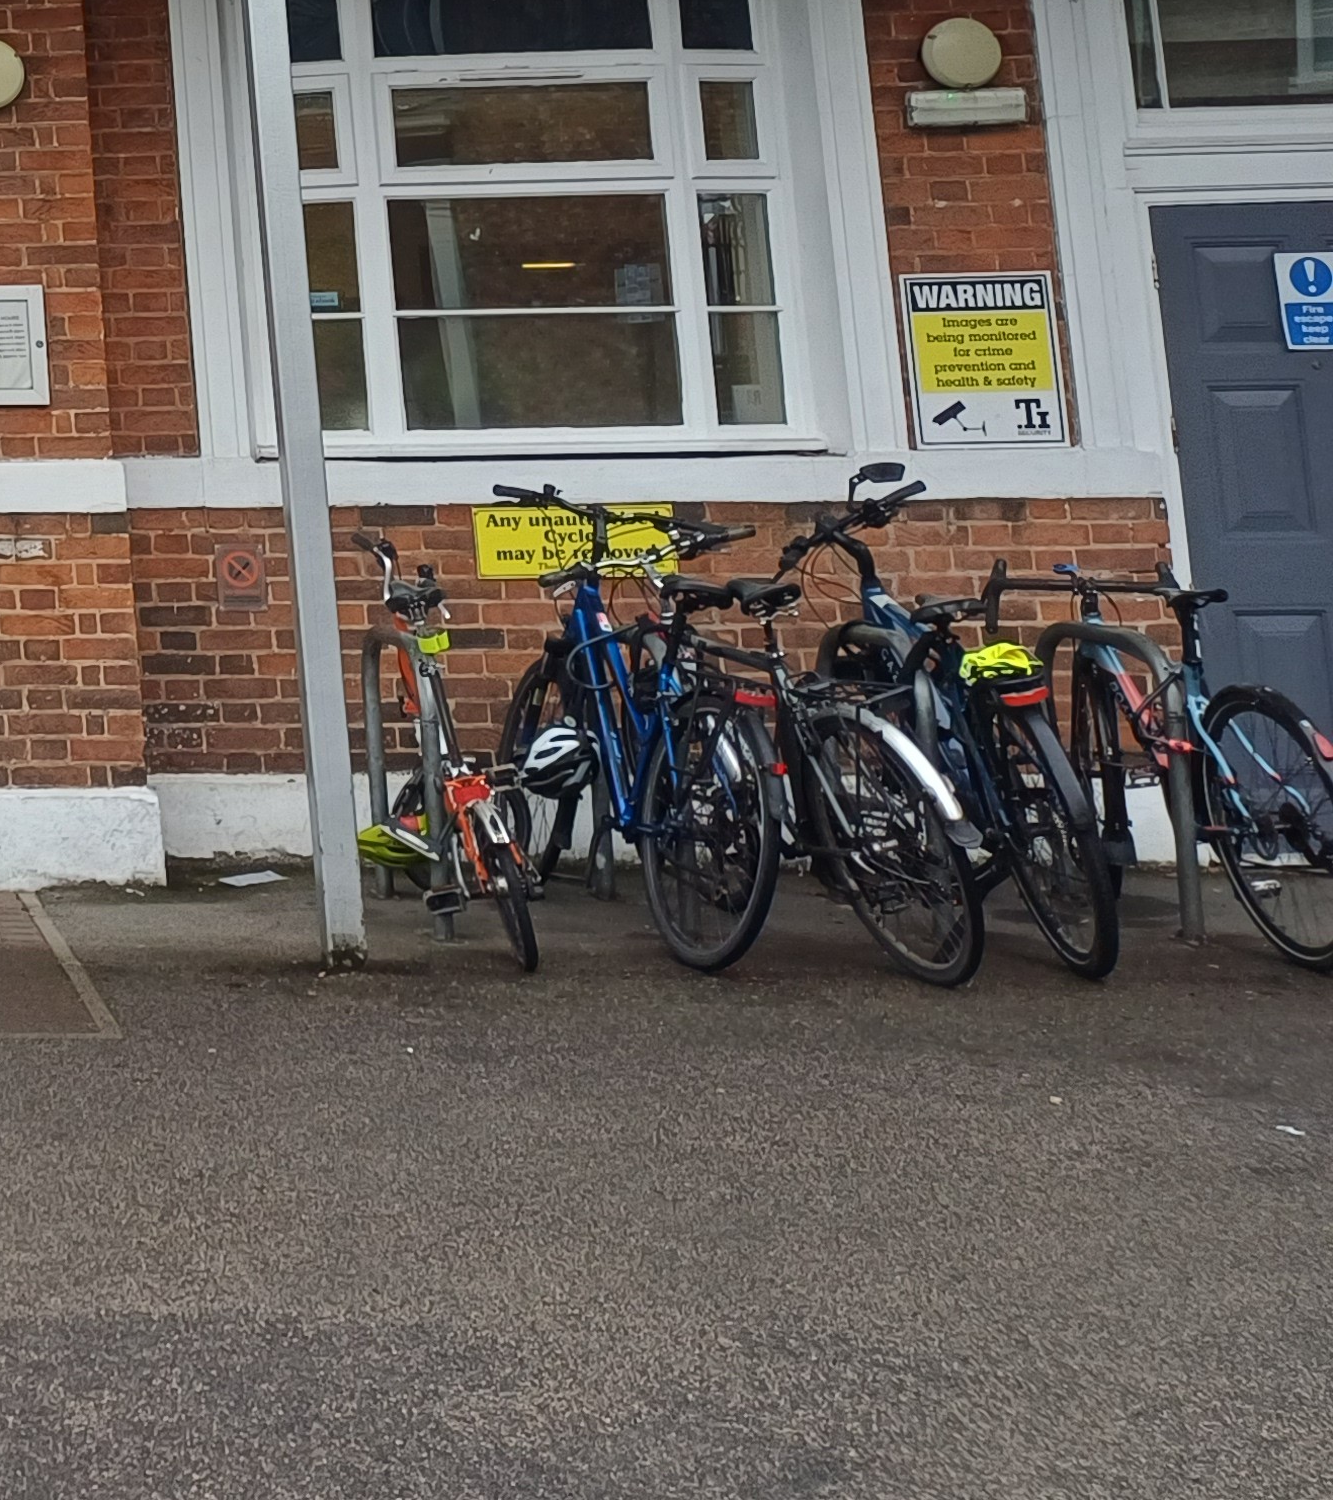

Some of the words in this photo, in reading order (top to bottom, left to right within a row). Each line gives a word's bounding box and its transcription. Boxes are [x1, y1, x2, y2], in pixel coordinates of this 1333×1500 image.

[912, 282, 1042, 308] WARNING
[942, 317, 992, 329] Images
[996, 318, 1017, 326] are
[926, 332, 964, 344] being
[969, 330, 1037, 342] monitored
[953, 347, 971, 357] for
[975, 346, 1013, 356] crime
[934, 361, 1005, 374] prevention
[1009, 360, 1036, 370] and
[936, 377, 979, 387] health
[983, 376, 992, 386] &
[997, 375, 1036, 388] safety
[486, 514, 522, 531] Any
[496, 549, 536, 564] may
[542, 546, 566, 560] be
[573, 545, 657, 560] reove
